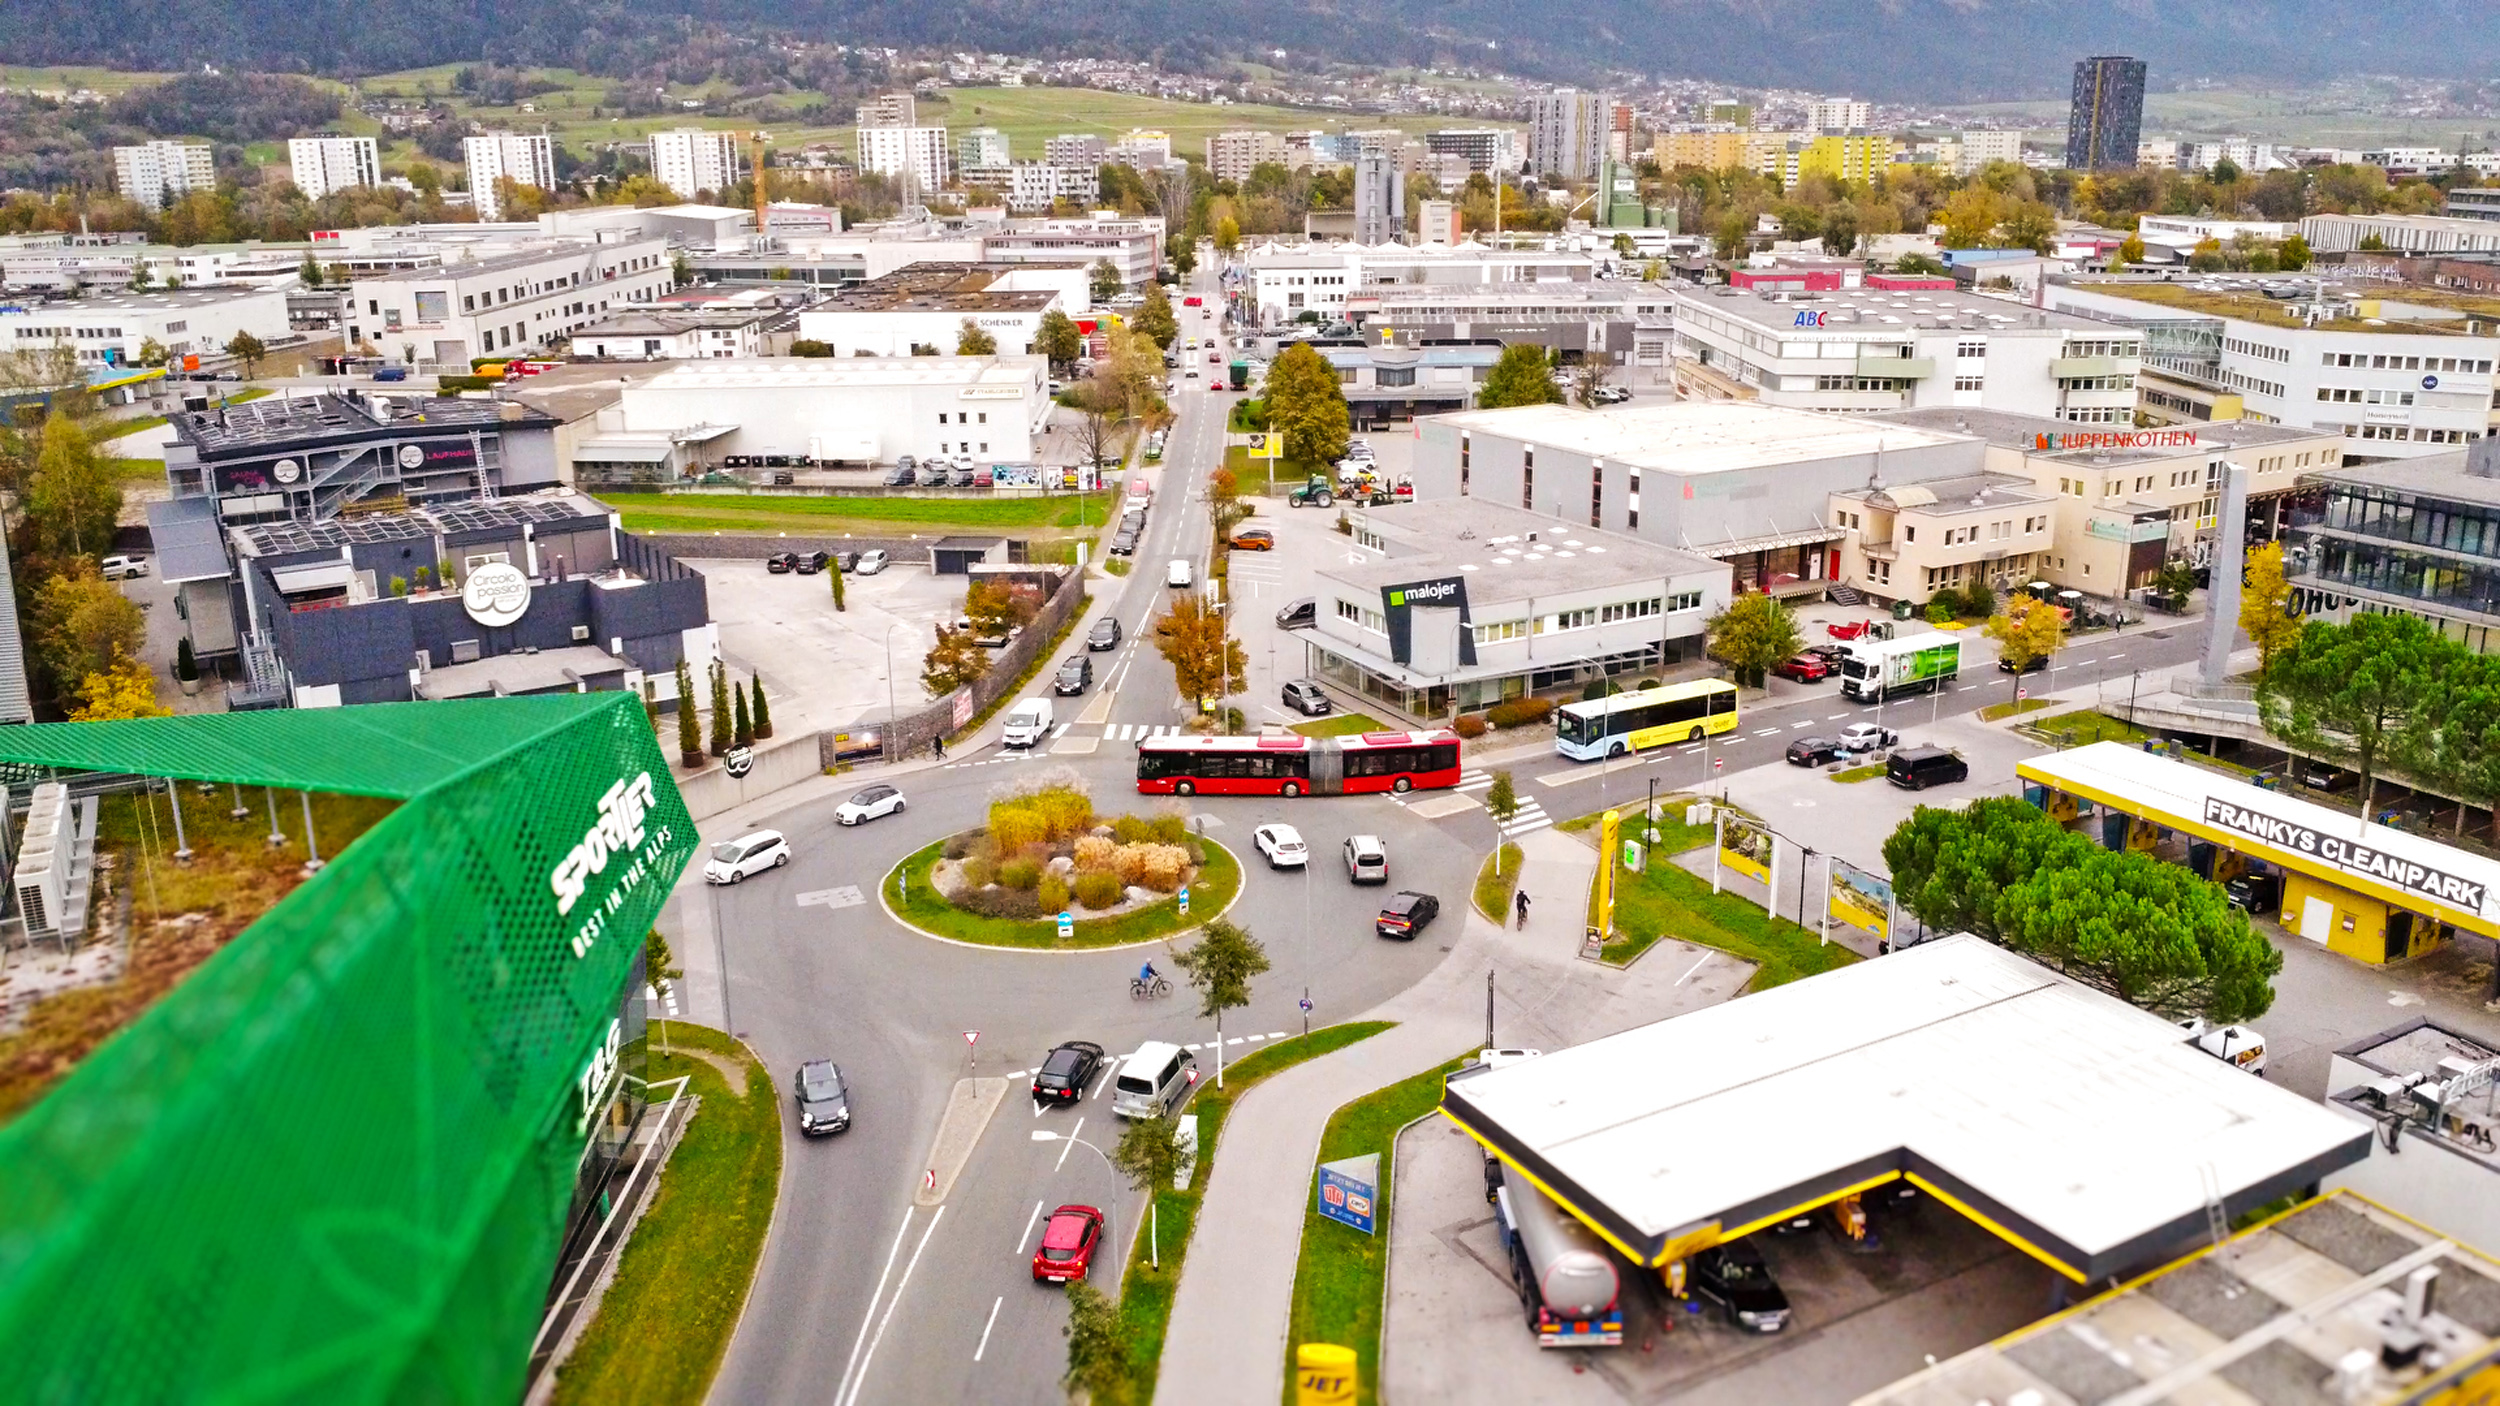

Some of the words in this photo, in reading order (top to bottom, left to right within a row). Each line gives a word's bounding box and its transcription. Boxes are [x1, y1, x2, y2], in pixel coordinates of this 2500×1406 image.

[980, 319, 1023, 327] SCHENKER
[1793, 310, 1828, 327] ABC
[2366, 411, 2409, 420] Honeywell
[2055, 431, 2197, 448] HUPPENKOTHEN
[473, 572, 517, 587] Circolo
[477, 583, 525, 600] passion
[1404, 582, 1457, 600] malojer
[2206, 801, 2316, 851] FRANKYS
[2321, 838, 2482, 908] CLEANPARK
[571, 908, 606, 960] BEST
[605, 887, 624, 917] IN
[621, 857, 648, 894] THE
[645, 825, 673, 866] ALPS
[1303, 1374, 1350, 1393] JET
